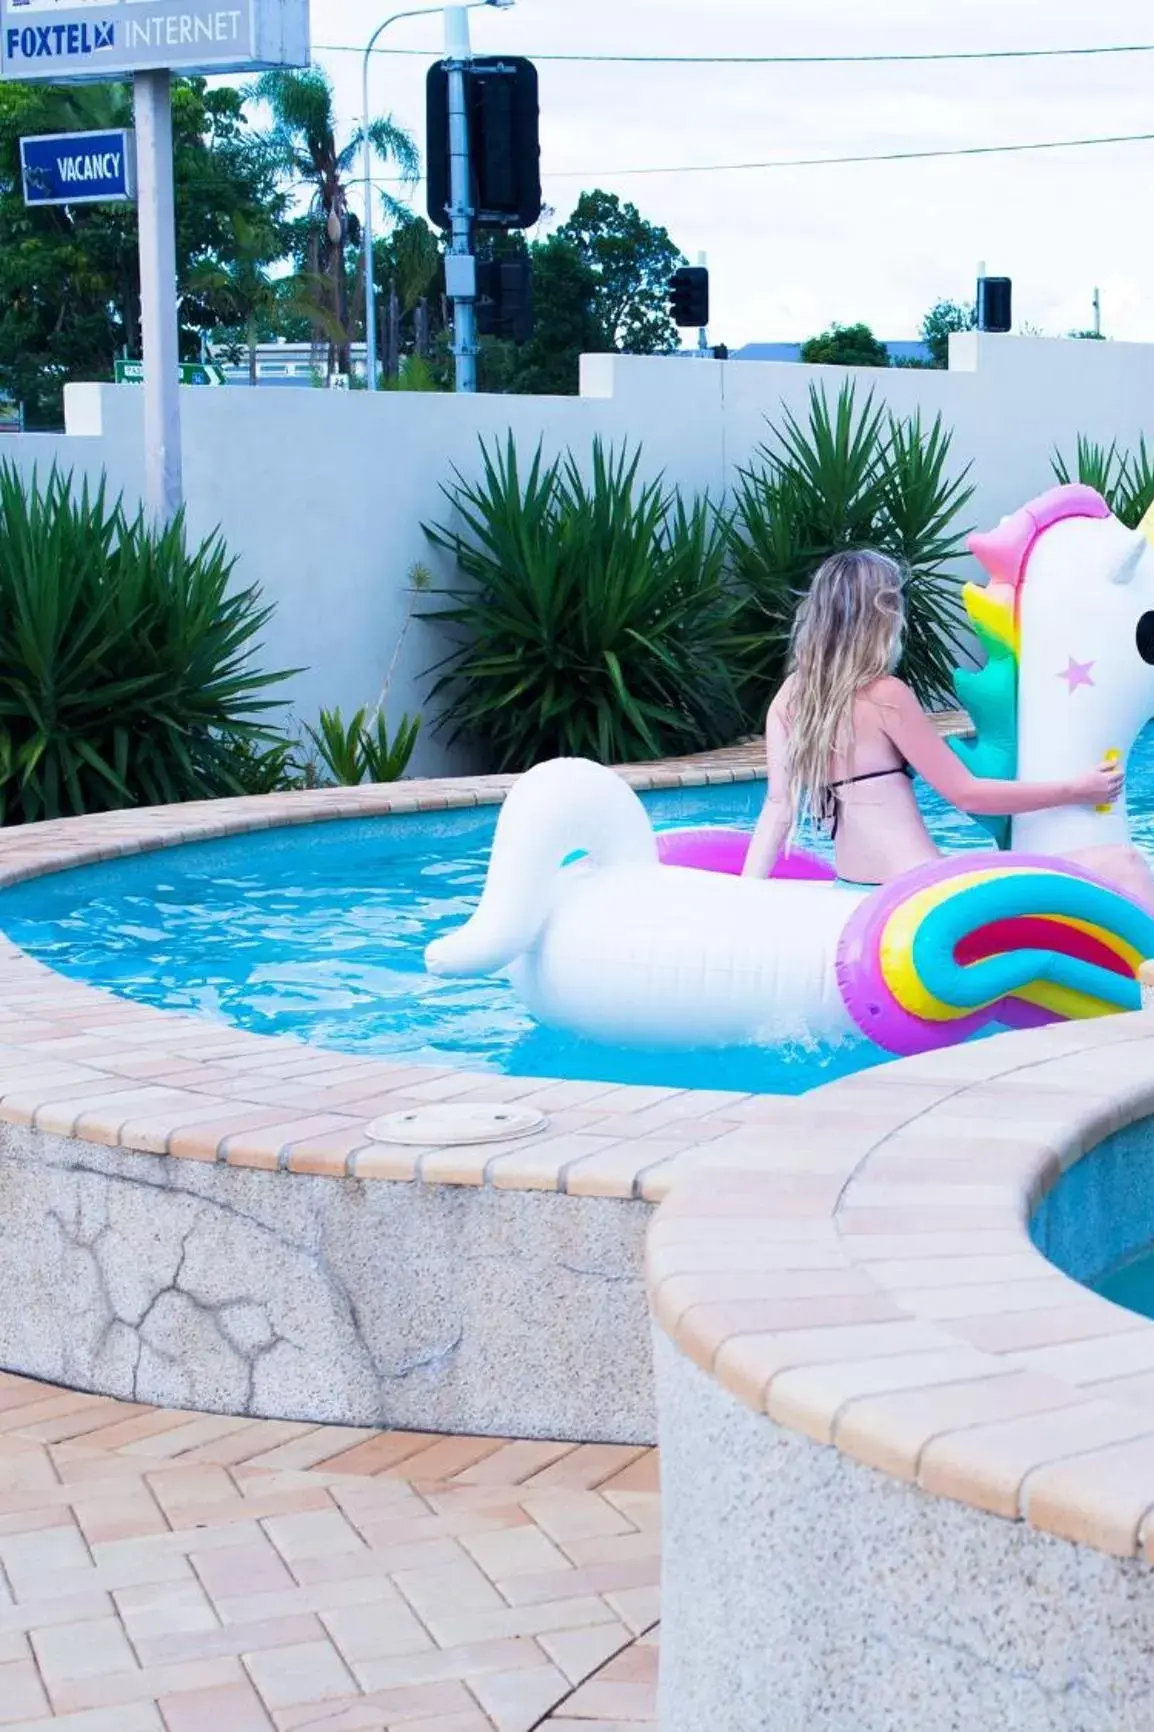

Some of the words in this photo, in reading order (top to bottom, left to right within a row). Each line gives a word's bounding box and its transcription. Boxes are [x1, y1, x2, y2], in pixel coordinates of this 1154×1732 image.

[7, 23, 91, 58] FOXTEL
[124, 10, 241, 48] INTERNET
[57, 152, 121, 182] VACANCY
